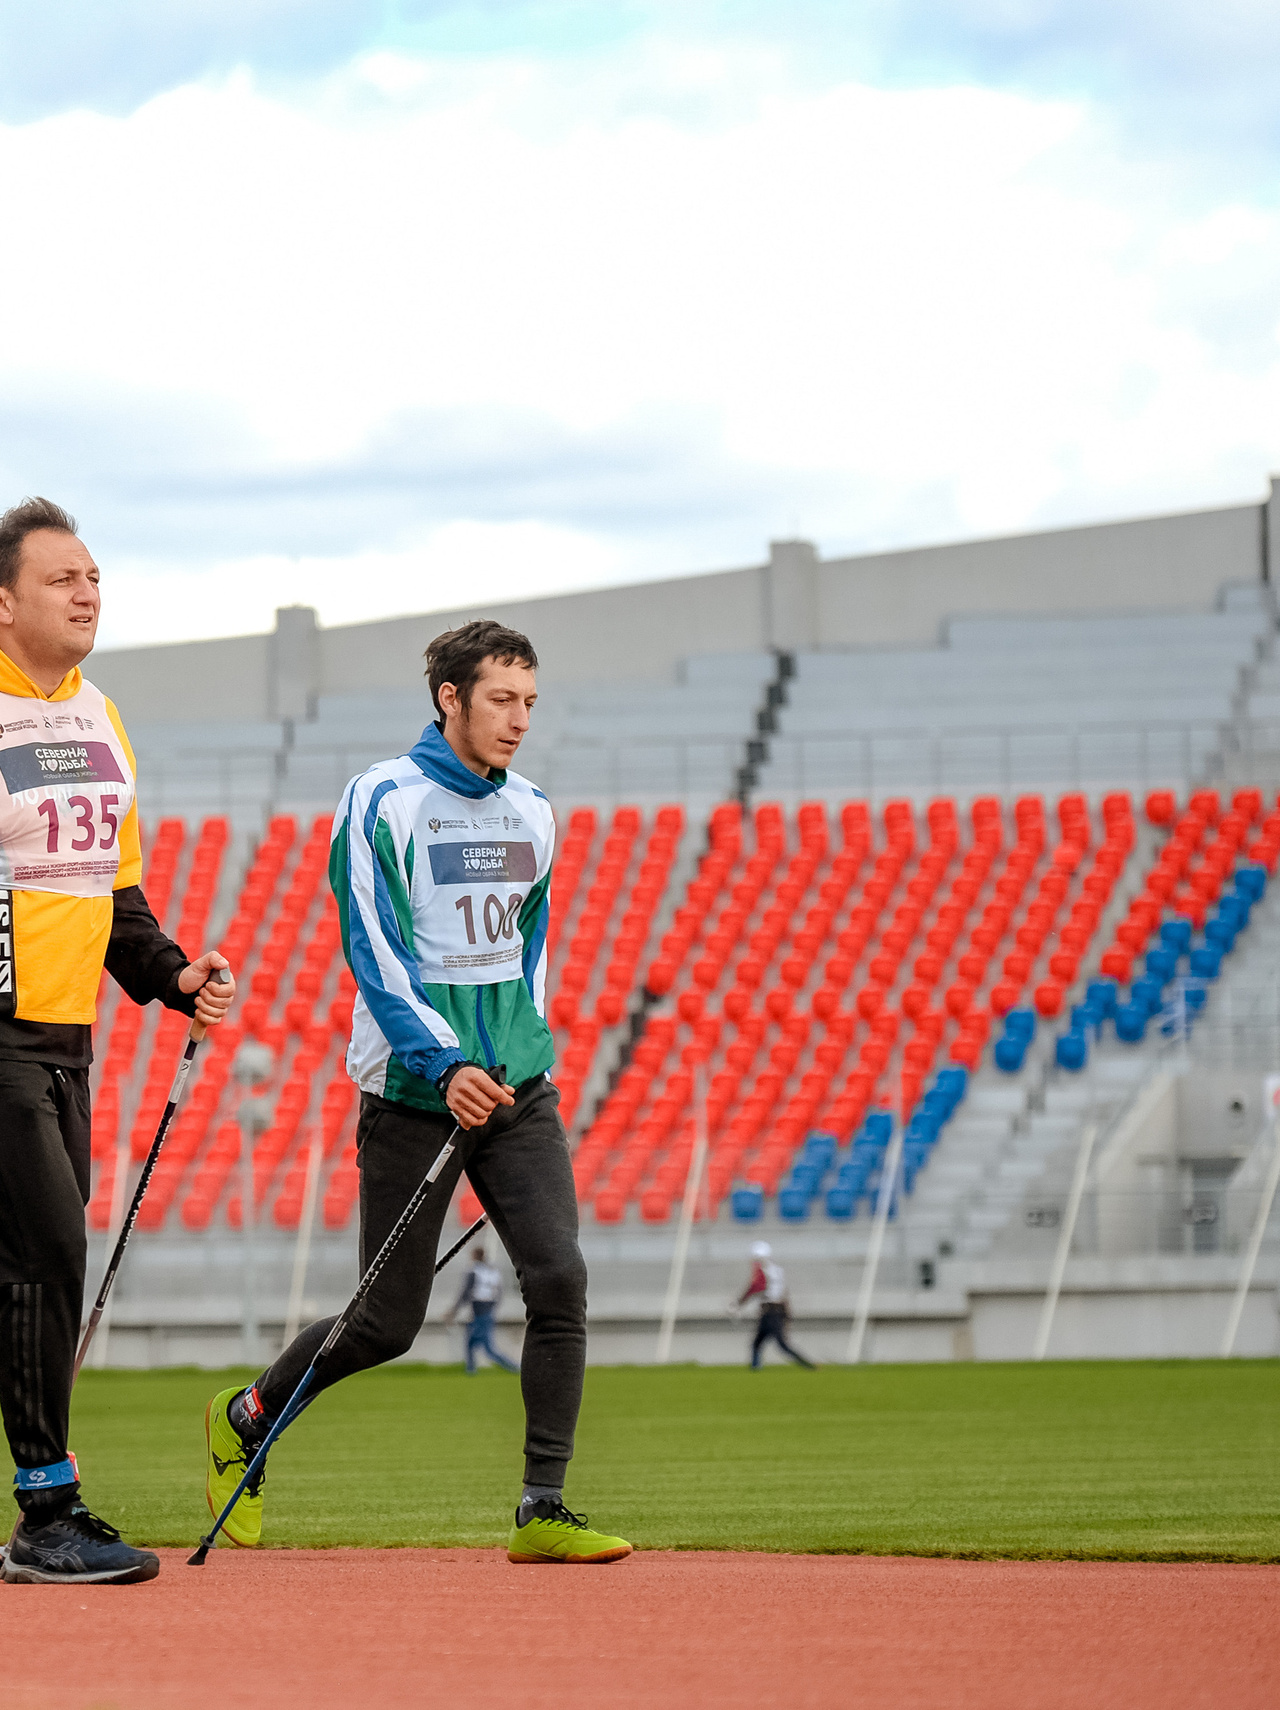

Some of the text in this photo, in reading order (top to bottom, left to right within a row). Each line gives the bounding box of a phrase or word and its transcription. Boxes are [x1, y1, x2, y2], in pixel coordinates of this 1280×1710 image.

[35, 747, 89, 759] СЕВЕРНАЯ
[38, 794, 119, 853] 135
[462, 846, 507, 859] СЕВЕРНАЯ
